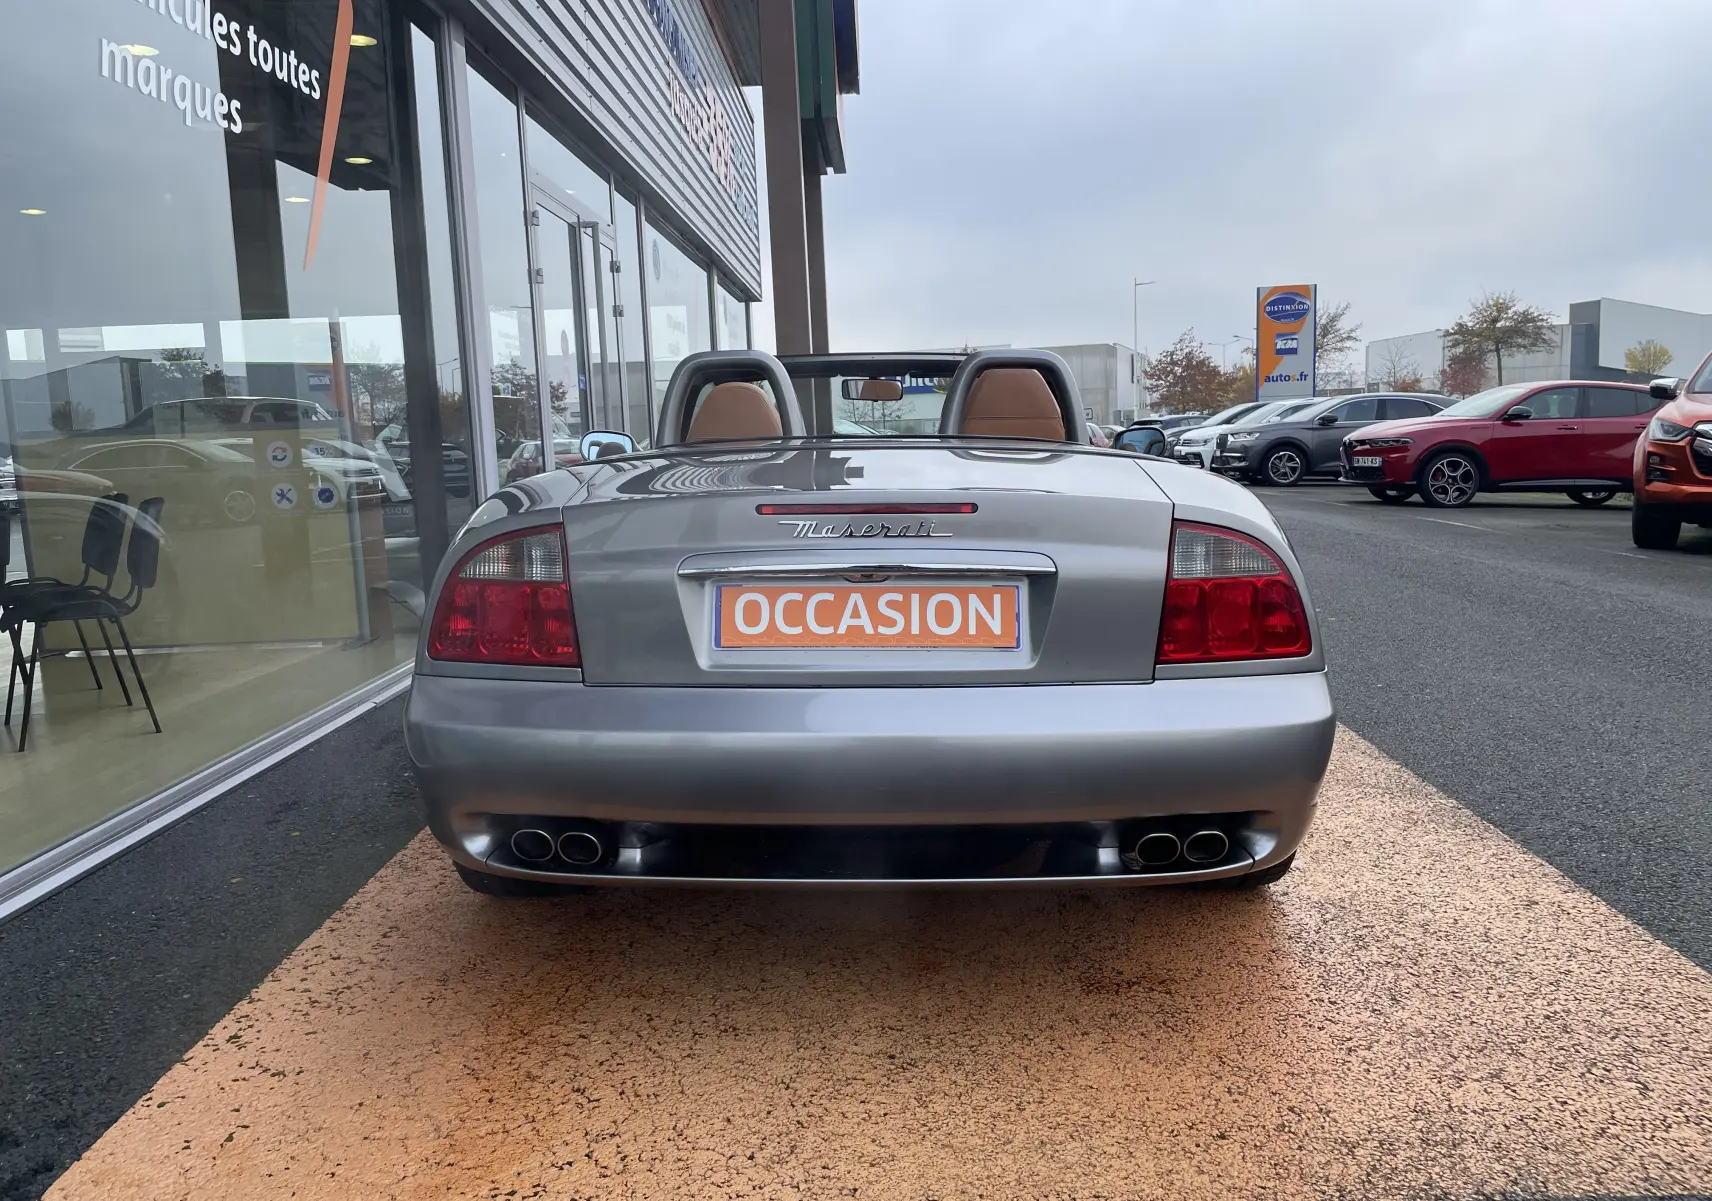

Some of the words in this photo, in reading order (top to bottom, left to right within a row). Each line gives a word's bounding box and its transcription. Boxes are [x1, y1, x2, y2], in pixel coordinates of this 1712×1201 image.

[247, 25, 321, 100] toutes
[101, 38, 243, 134] marques
[1266, 304, 1309, 312] DISTINXION
[1264, 371, 1309, 383] autos.fr
[778, 520, 953, 538] Maserati
[734, 592, 1003, 636] OCCASION
